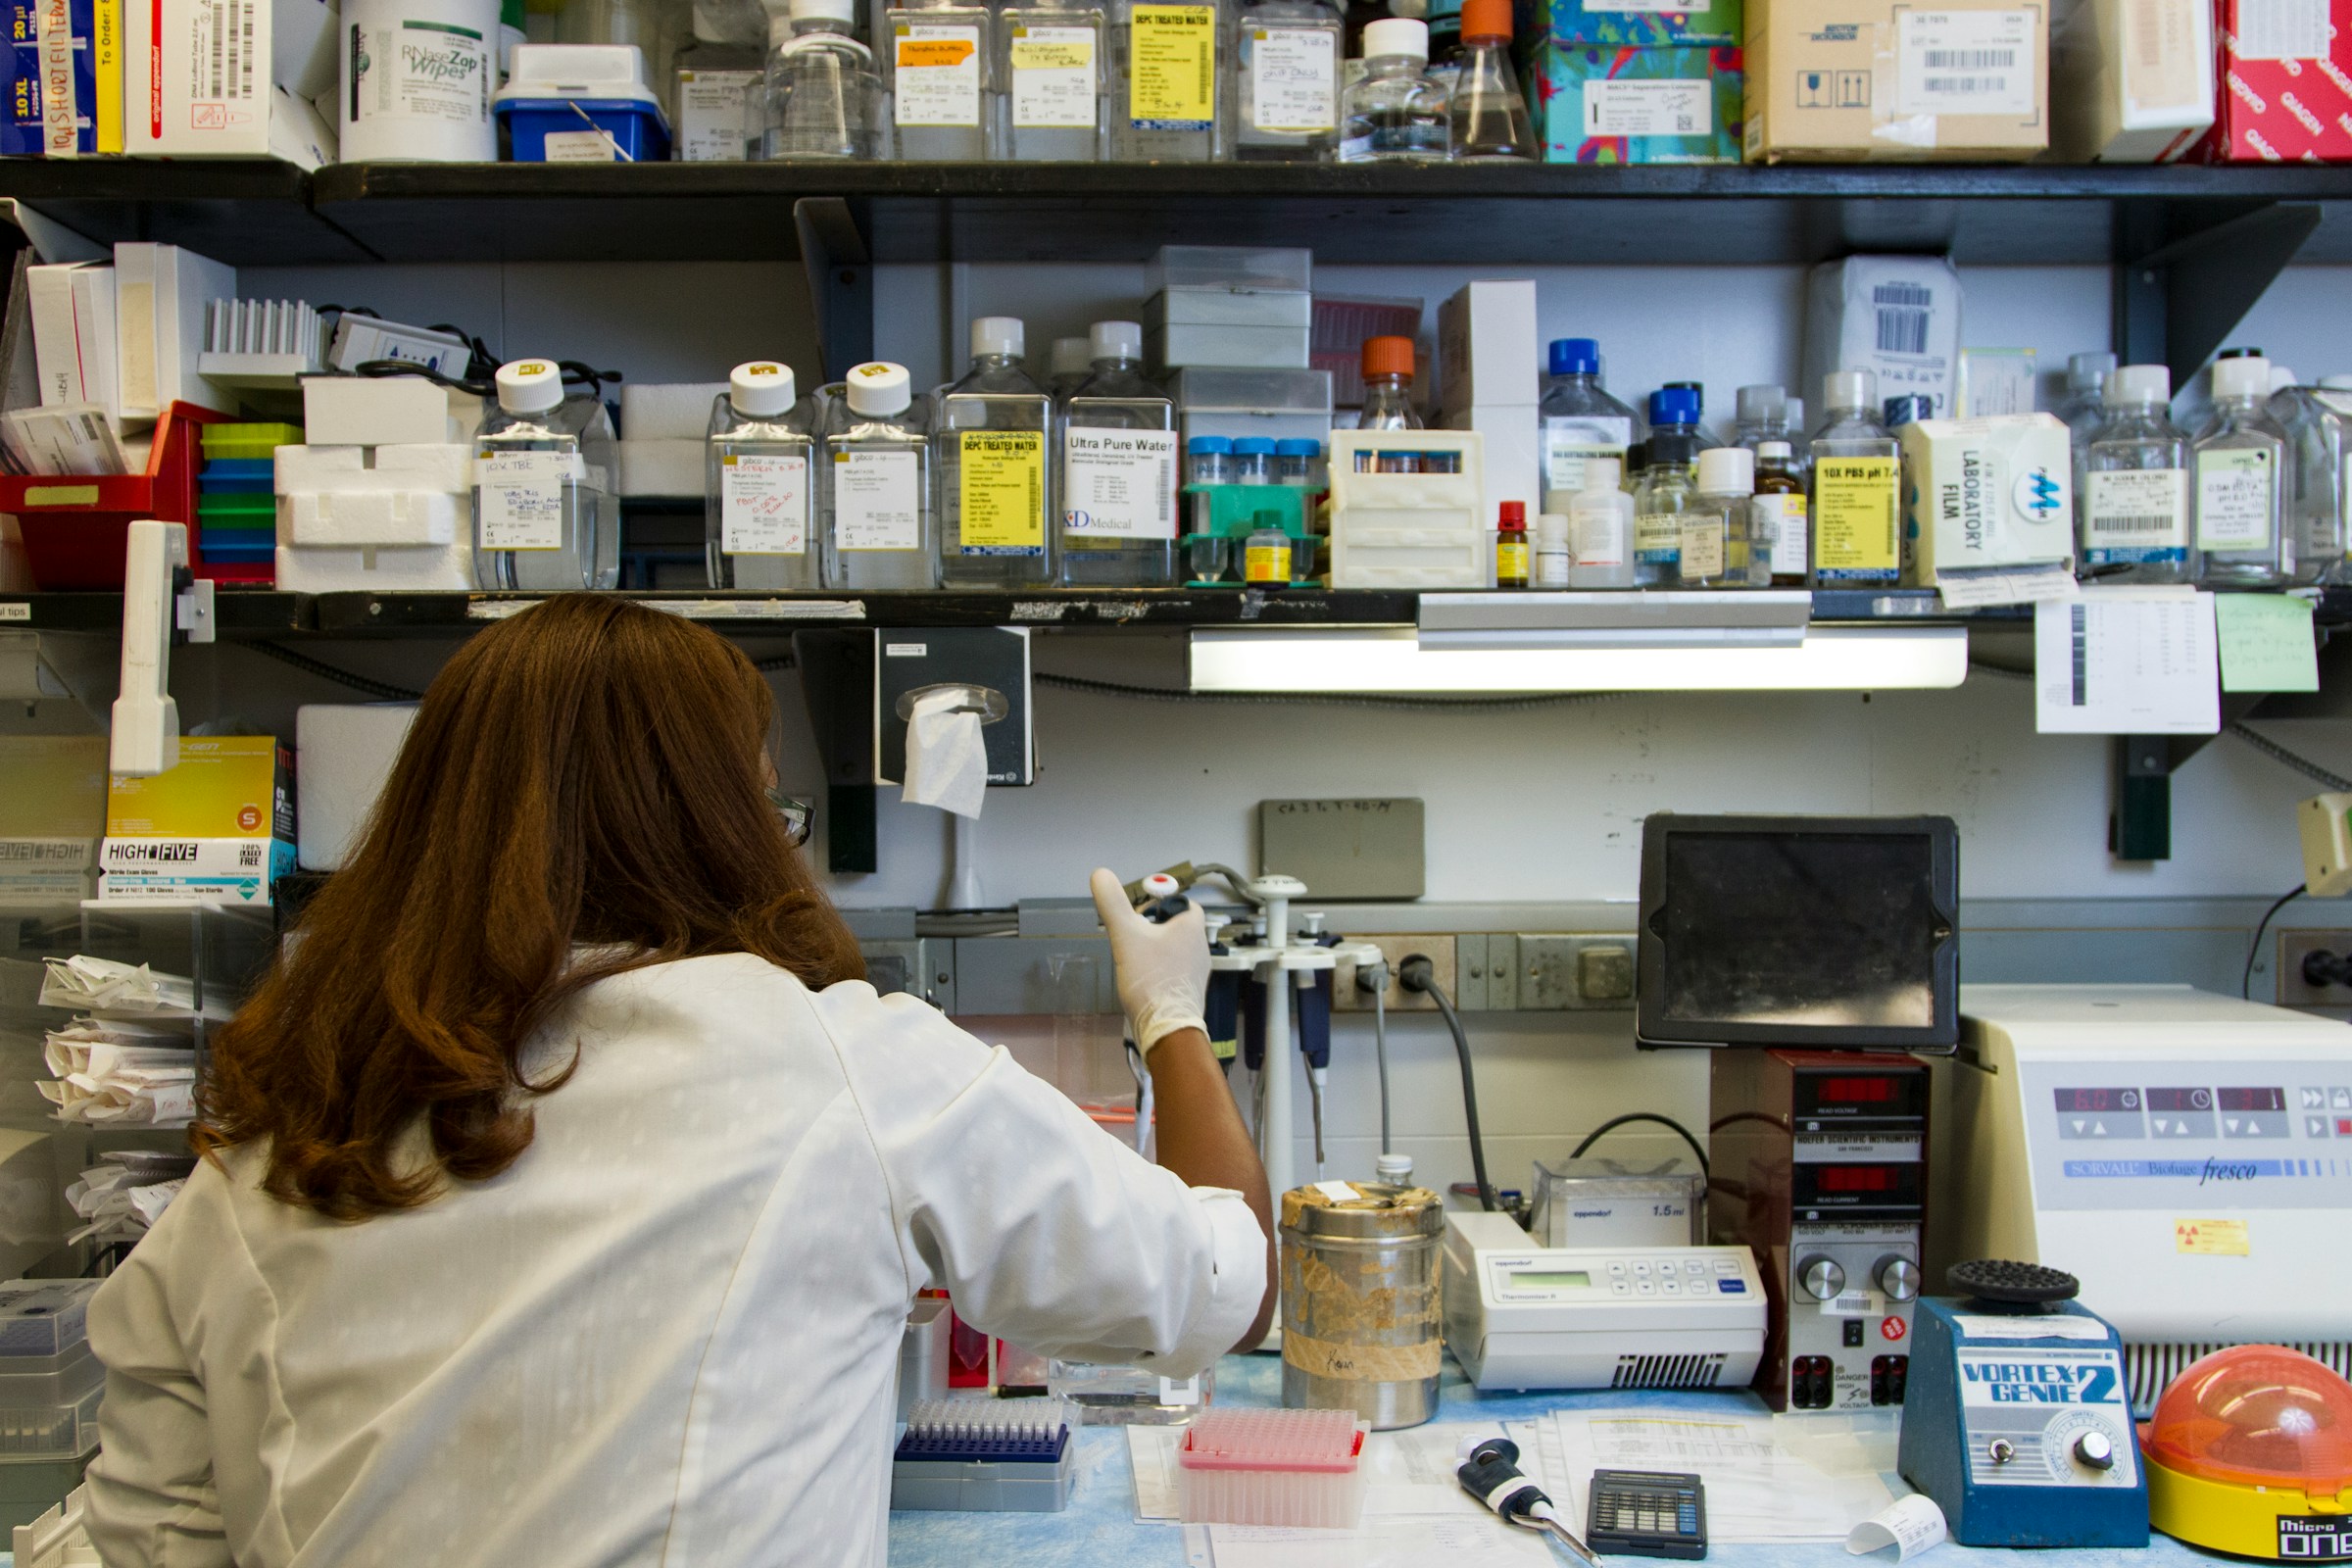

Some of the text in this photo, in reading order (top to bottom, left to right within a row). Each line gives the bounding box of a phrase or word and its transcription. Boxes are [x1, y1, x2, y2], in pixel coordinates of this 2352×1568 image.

[1136, 15, 1208, 25] DEPC TREATED WATER
[14, 21, 25, 39] 20
[102, 9, 111, 65] To Order:
[412, 60, 466, 80] Wipes
[151, 45, 161, 123] original eppendorf
[16, 78, 28, 117] 10 XL
[49, 69, 70, 122] SHORT
[2280, 92, 2325, 136] QIAGEN
[964, 440, 1038, 451] DEPC TREATED WATER
[1070, 436, 1173, 451] Ultra Pure Water
[511, 461, 534, 469] TBE
[742, 457, 762, 466] gibco
[854, 454, 874, 463] gibco
[1824, 467, 1842, 478] 10X
[1845, 467, 1864, 478] PBS
[1867, 467, 1881, 480] pH
[1942, 484, 1960, 520] FILM
[1963, 451, 1982, 551] LABORATORY
[1090, 517, 1132, 529] Medical
[8, 608, 25, 616] tips
[242, 812, 256, 825] S
[109, 844, 198, 860] HIGH FIVE
[240, 857, 259, 865] FREE
[2241, 1089, 2253, 1110] 3
[2148, 1160, 2197, 1177] Biofuge
[2199, 1155, 2257, 1186] fresco
[1574, 1204, 1685, 1219] eppendorf 1.5 ml
[1990, 1365, 2122, 1403] GENIE 2
